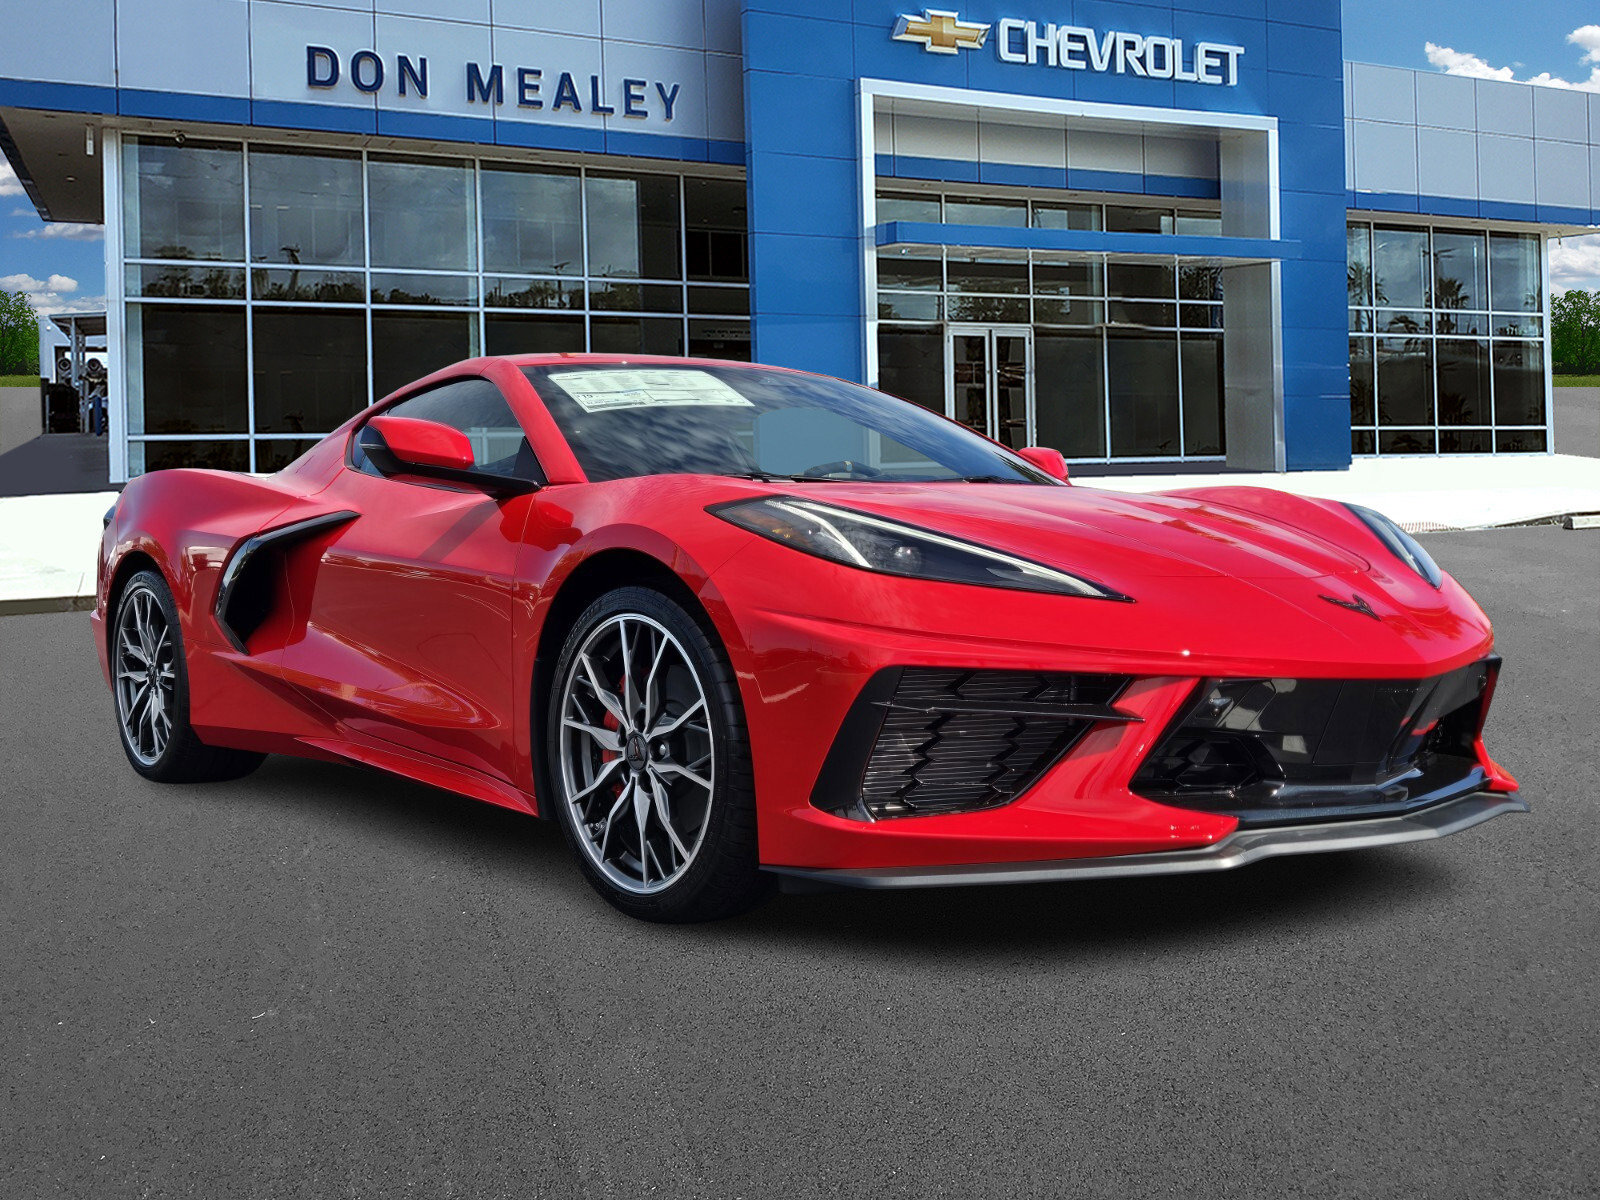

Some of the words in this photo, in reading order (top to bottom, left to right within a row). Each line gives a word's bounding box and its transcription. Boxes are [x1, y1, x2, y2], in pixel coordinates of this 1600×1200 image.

[306, 45, 428, 98] DON
[466, 61, 680, 121] MEALEY
[997, 17, 1245, 86] CHEVROLET
